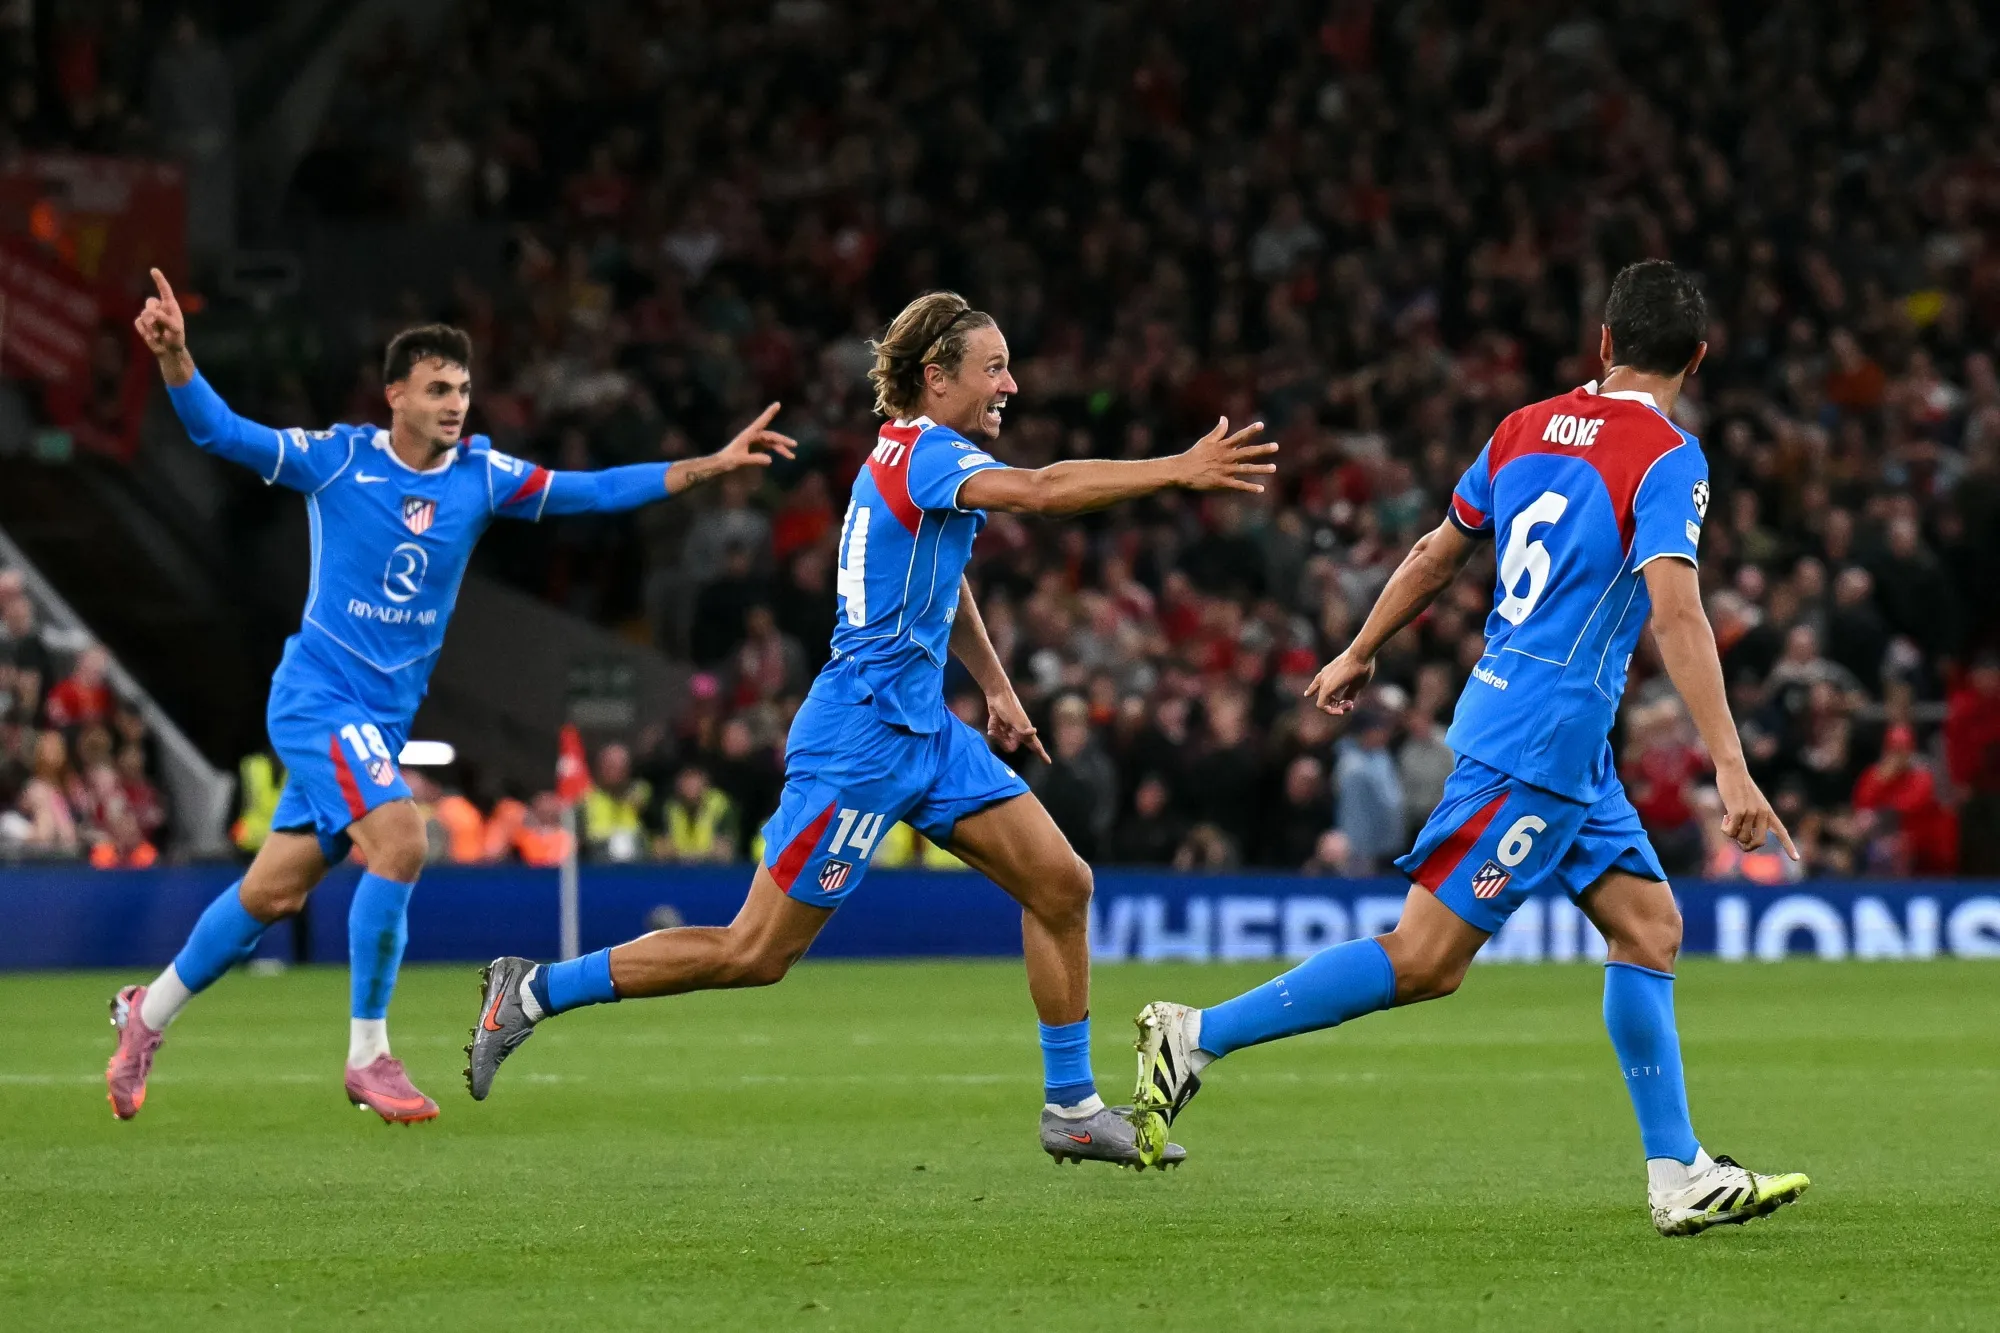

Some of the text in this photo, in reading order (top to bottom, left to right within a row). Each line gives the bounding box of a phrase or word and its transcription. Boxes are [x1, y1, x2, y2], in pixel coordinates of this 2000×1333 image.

[1542, 413, 1605, 446] KOKE
[1497, 490, 1568, 627] 6
[347, 598, 437, 626] RIYADH AIR
[340, 723, 391, 761] 18
[827, 808, 886, 860] 14
[1496, 815, 1548, 867] 6
